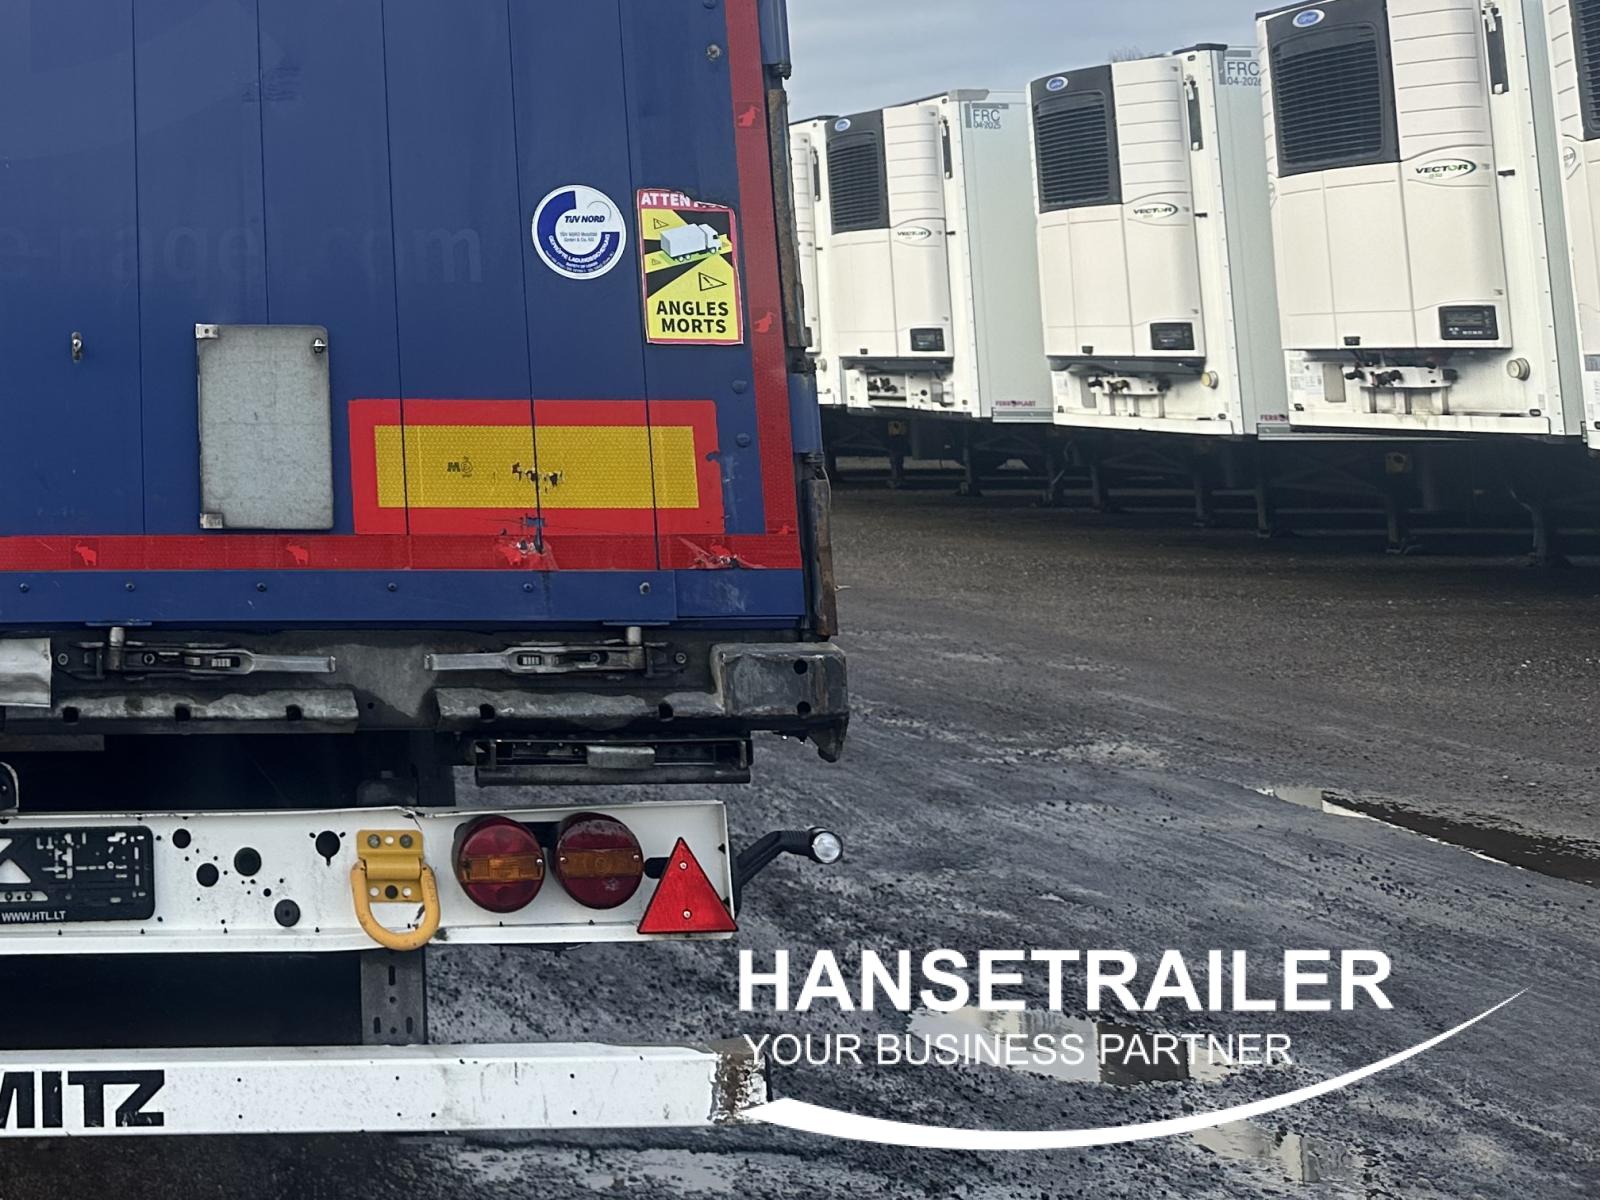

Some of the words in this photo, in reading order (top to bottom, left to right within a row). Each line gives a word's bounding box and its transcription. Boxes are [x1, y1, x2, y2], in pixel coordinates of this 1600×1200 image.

[1227, 61, 1260, 76] FRC
[973, 109, 1000, 121] FRC
[1415, 163, 1469, 174] VECTOR
[581, 215, 606, 224] NORD
[656, 301, 729, 317] ANGLES
[661, 318, 727, 334] MORTS
[1, 910, 67, 922] WWW.HTL.LT
